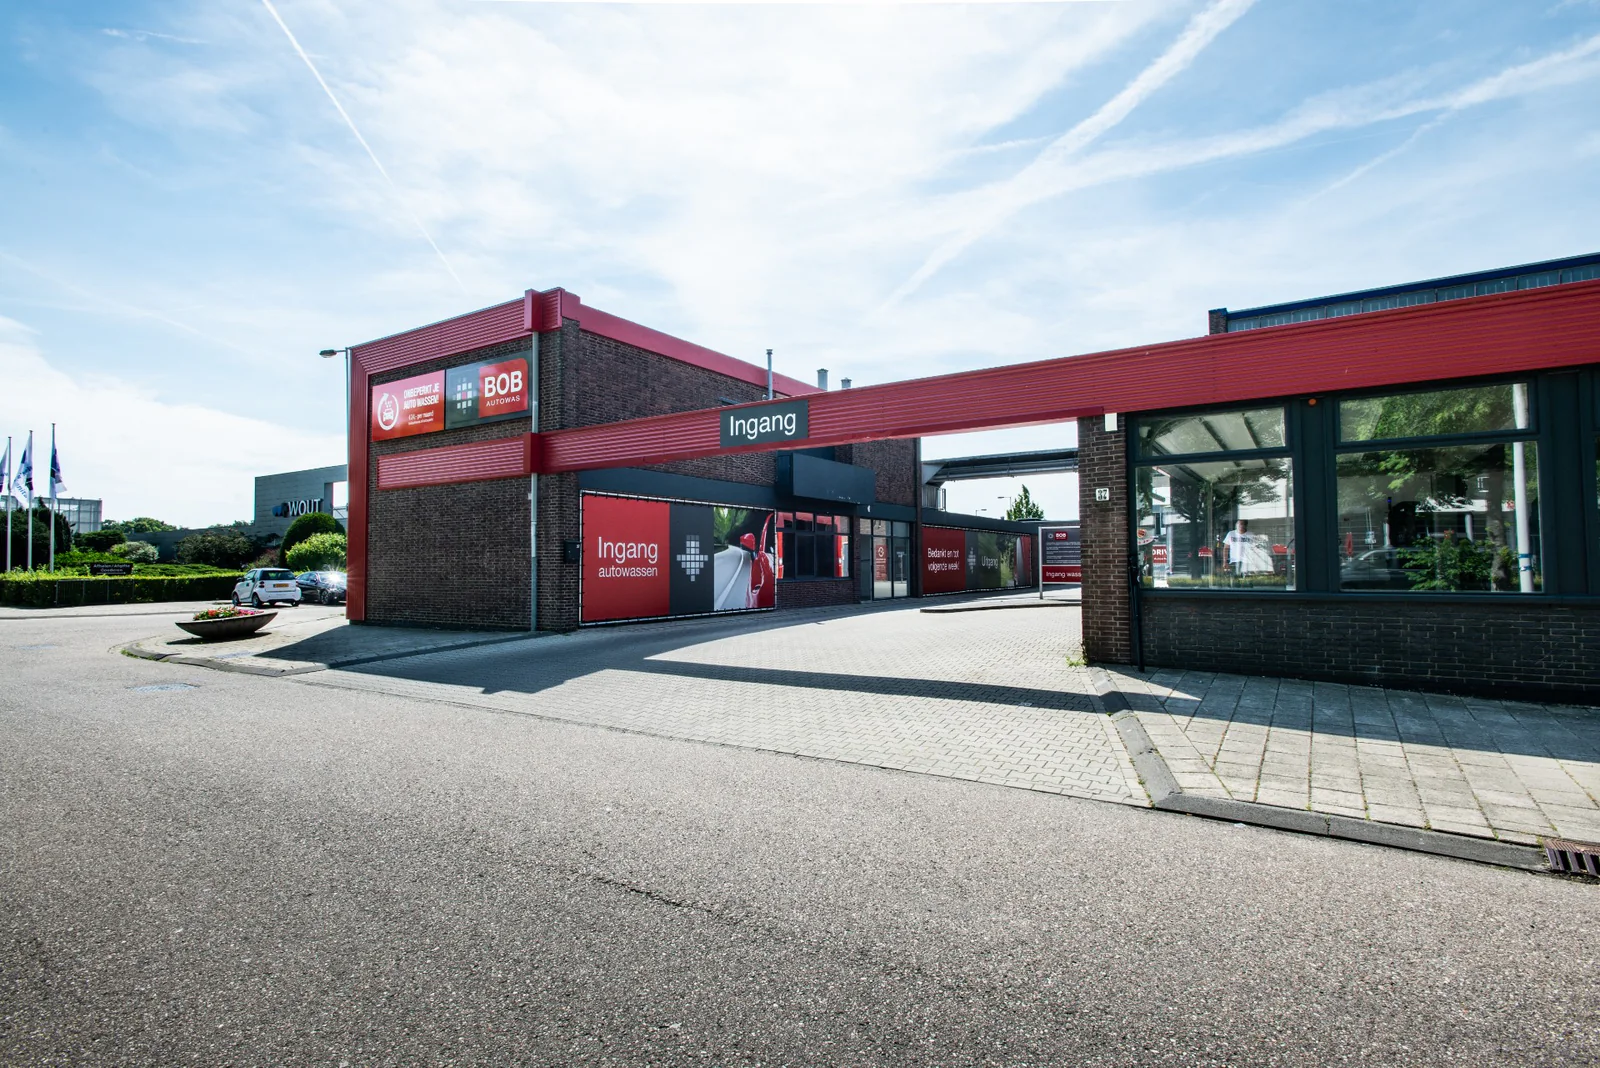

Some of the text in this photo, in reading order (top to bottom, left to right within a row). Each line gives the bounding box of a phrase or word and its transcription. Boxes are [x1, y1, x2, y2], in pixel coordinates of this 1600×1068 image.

[403, 382, 440, 399] ONBEPERKT JE
[484, 370, 523, 398] BOB
[403, 399, 416, 410] AUTO
[485, 395, 521, 407] AUTOWAS
[729, 413, 796, 440] Ingang
[288, 498, 321, 517] WOUT
[598, 536, 658, 564] Ingang
[927, 547, 947, 558] Bedankt
[947, 550, 954, 558] en
[927, 561, 948, 574] volgende
[981, 556, 999, 569] Uitgang
[598, 565, 658, 578] autowassen
